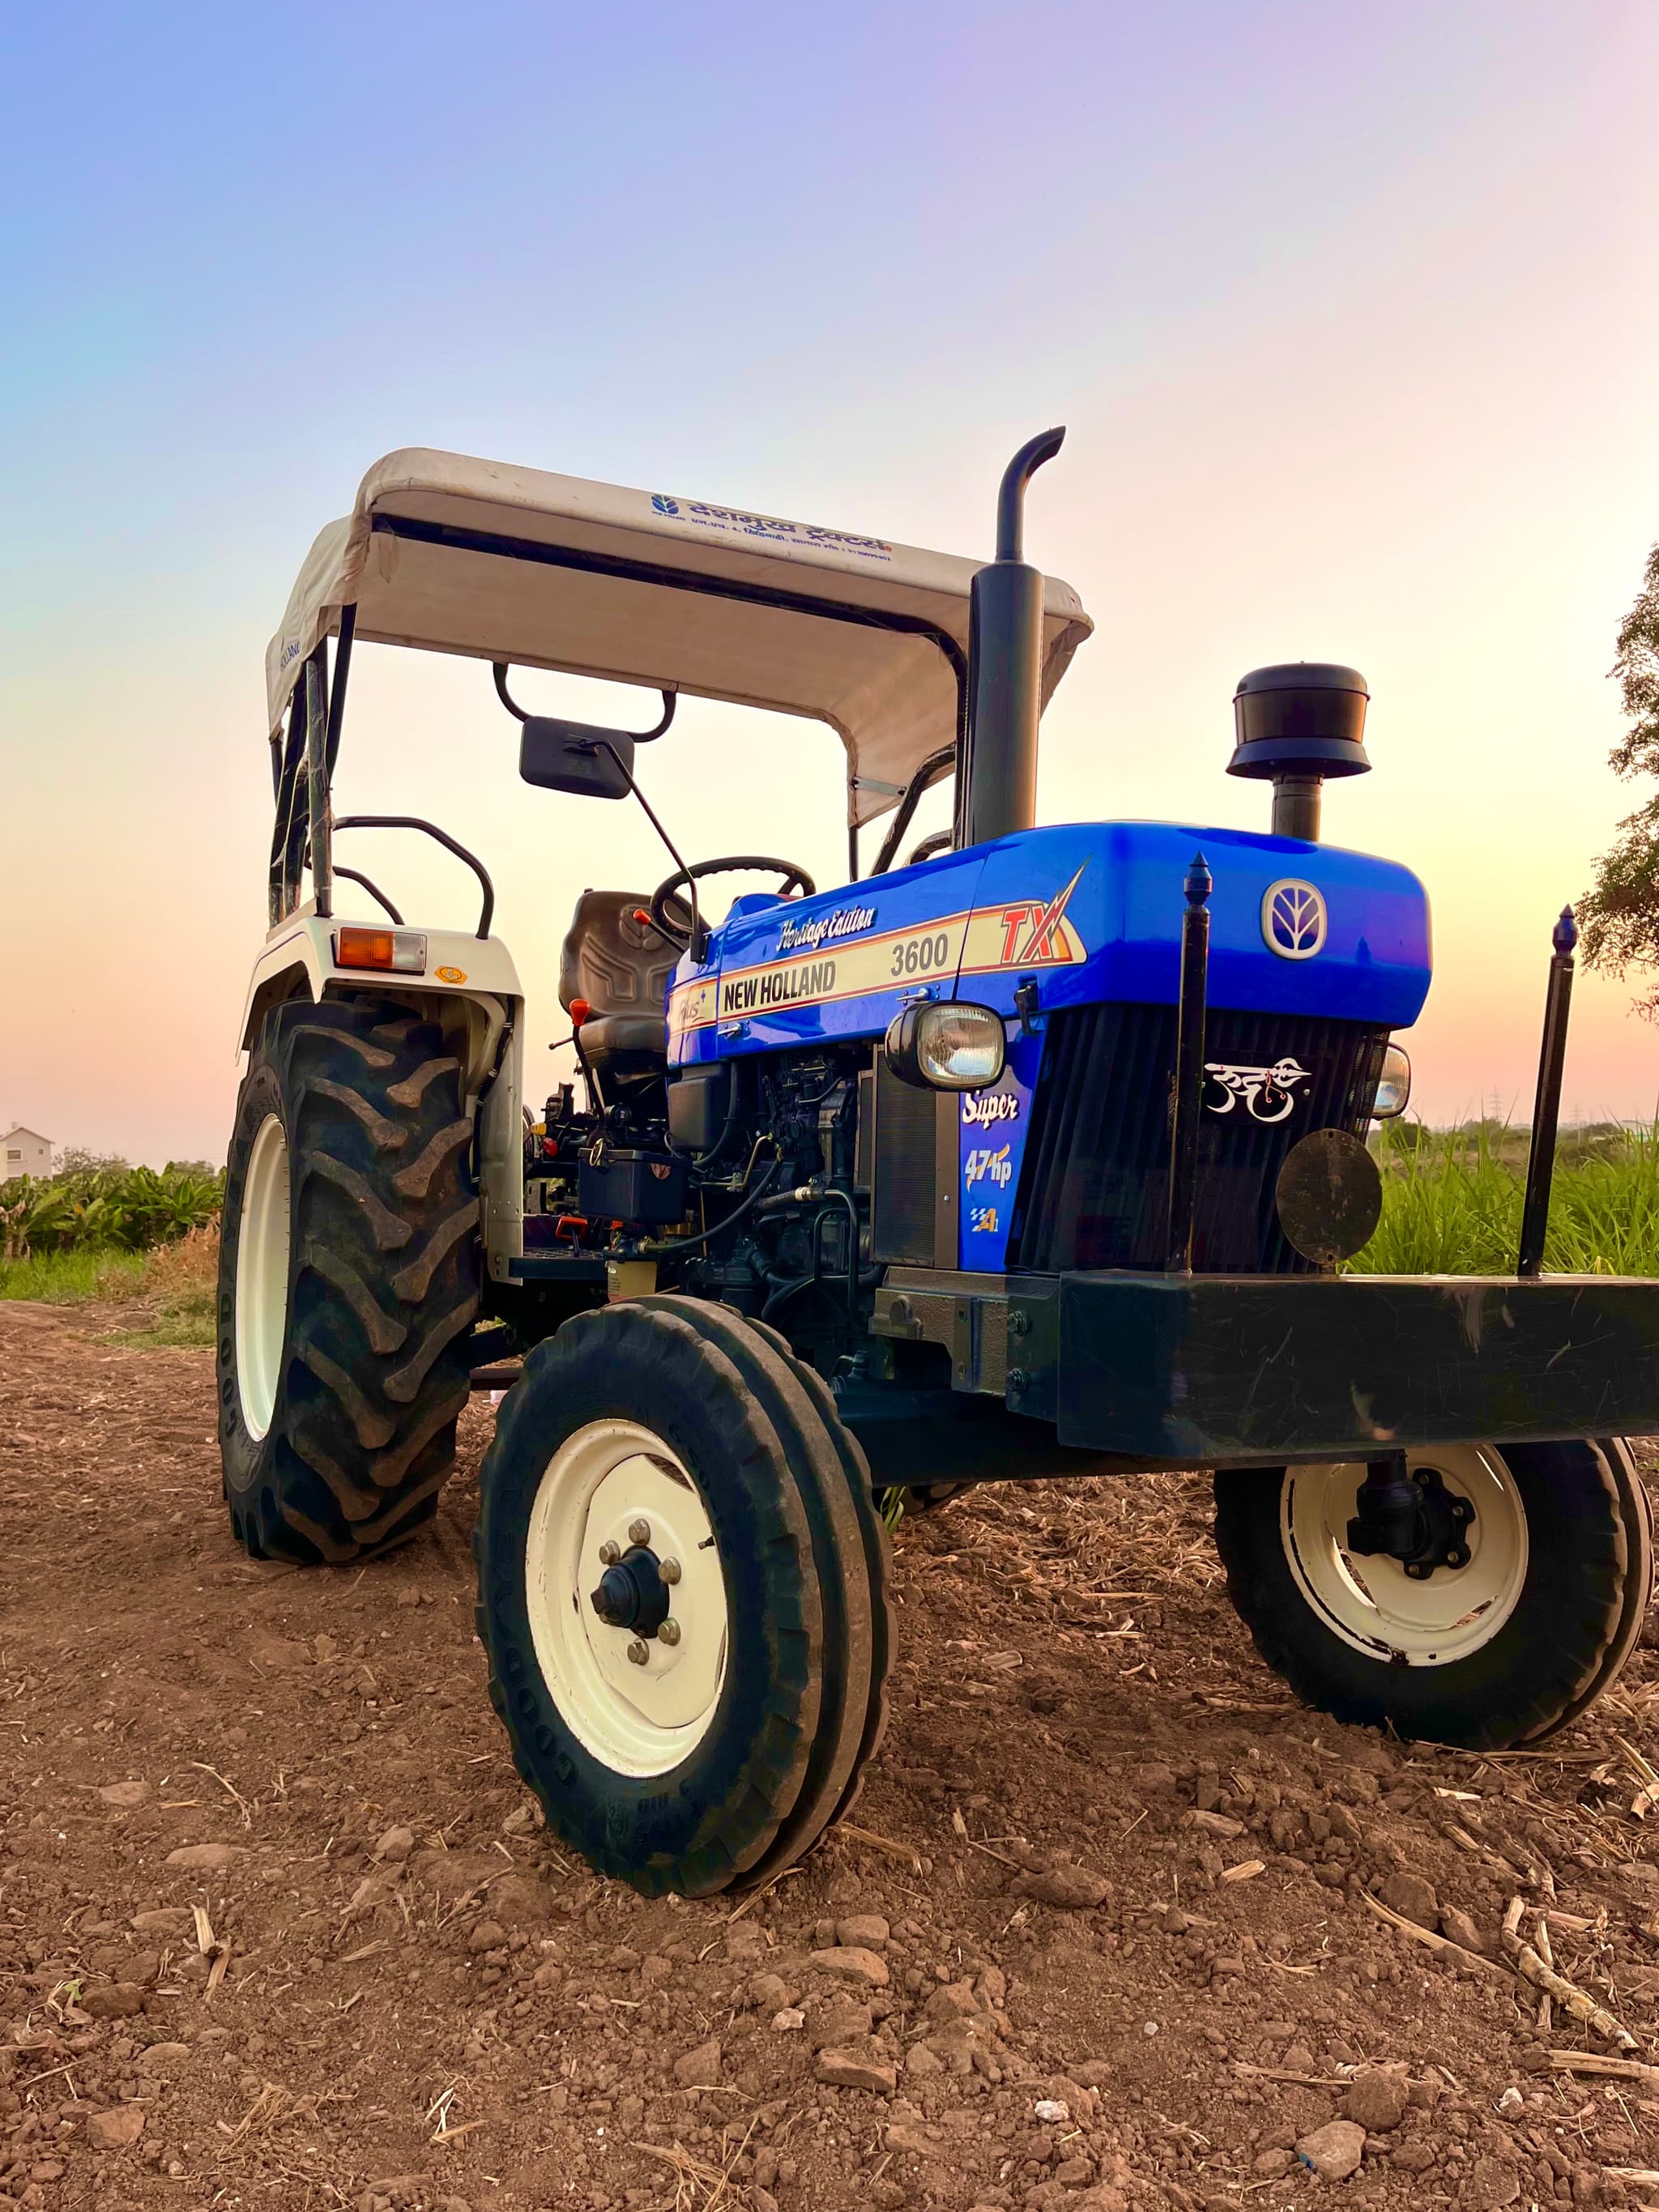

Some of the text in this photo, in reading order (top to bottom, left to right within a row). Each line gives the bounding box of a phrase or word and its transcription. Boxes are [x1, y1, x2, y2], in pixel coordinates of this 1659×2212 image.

[687, 502, 796, 533] देशमुख
[776, 905, 876, 951] Heritage Edition
[1000, 883, 1071, 965] TX
[890, 933, 949, 977] 3600
[724, 961, 836, 1012] NEW HOLLAND
[962, 1091, 1018, 1129] Super
